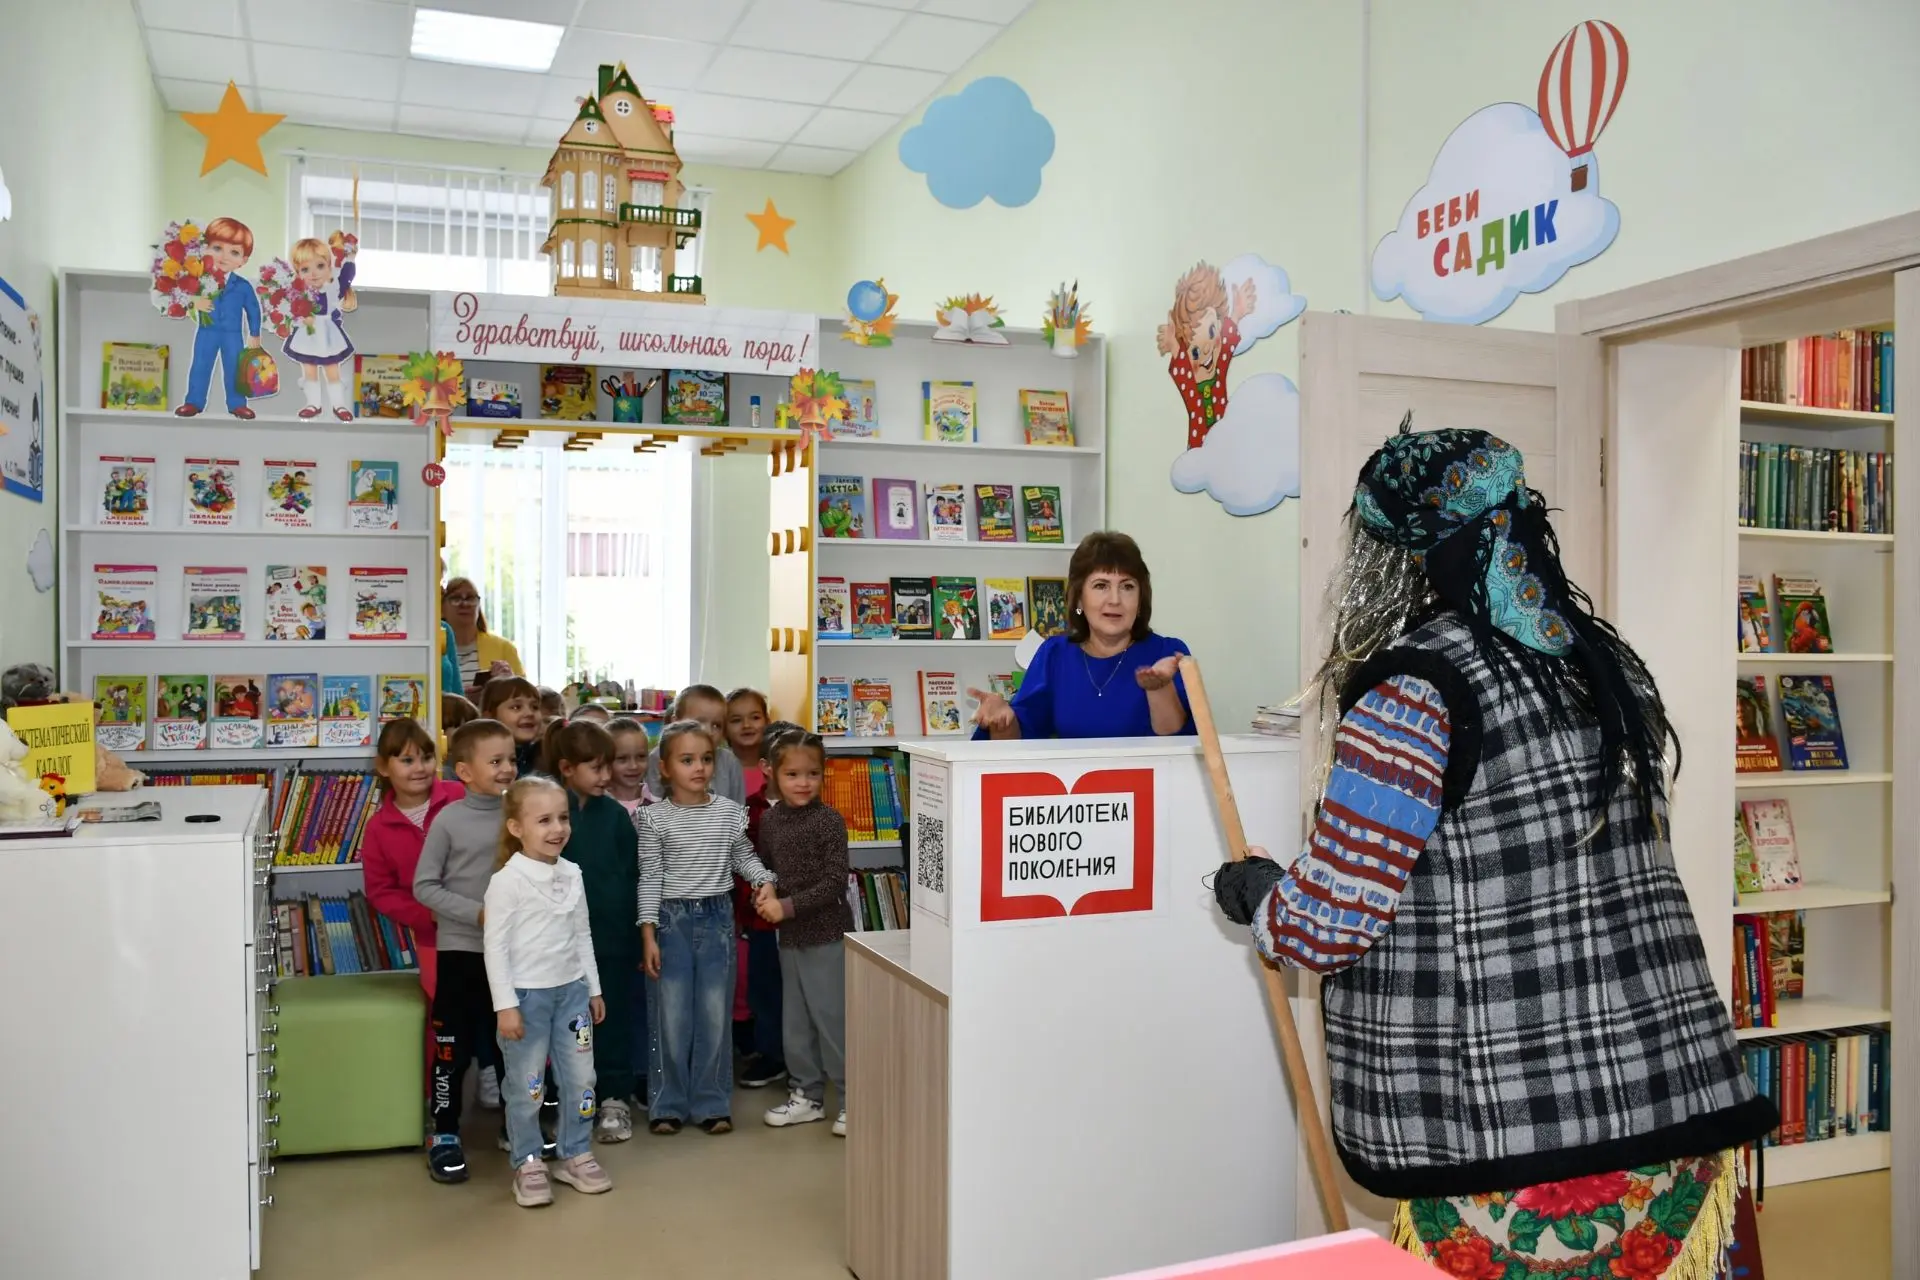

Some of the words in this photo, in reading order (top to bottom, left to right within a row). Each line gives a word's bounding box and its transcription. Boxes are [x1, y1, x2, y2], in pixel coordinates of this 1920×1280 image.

[1417, 188, 1480, 240] БЕБИ
[1433, 200, 1559, 277] САДИК
[453, 292, 604, 361] Здравствуй,
[619, 330, 731, 358] школьная
[743, 334, 810, 371] пора!
[425, 468, 444, 481] 0+
[36, 755, 72, 779] КАТАЛОГ
[1009, 802, 1129, 826] БИБЛИОТЕКА
[1009, 831, 1082, 853] НОВОГО
[1009, 856, 1116, 881] ПОКОЛЕНИЯ
[436, 1074, 449, 1109] YOUR
